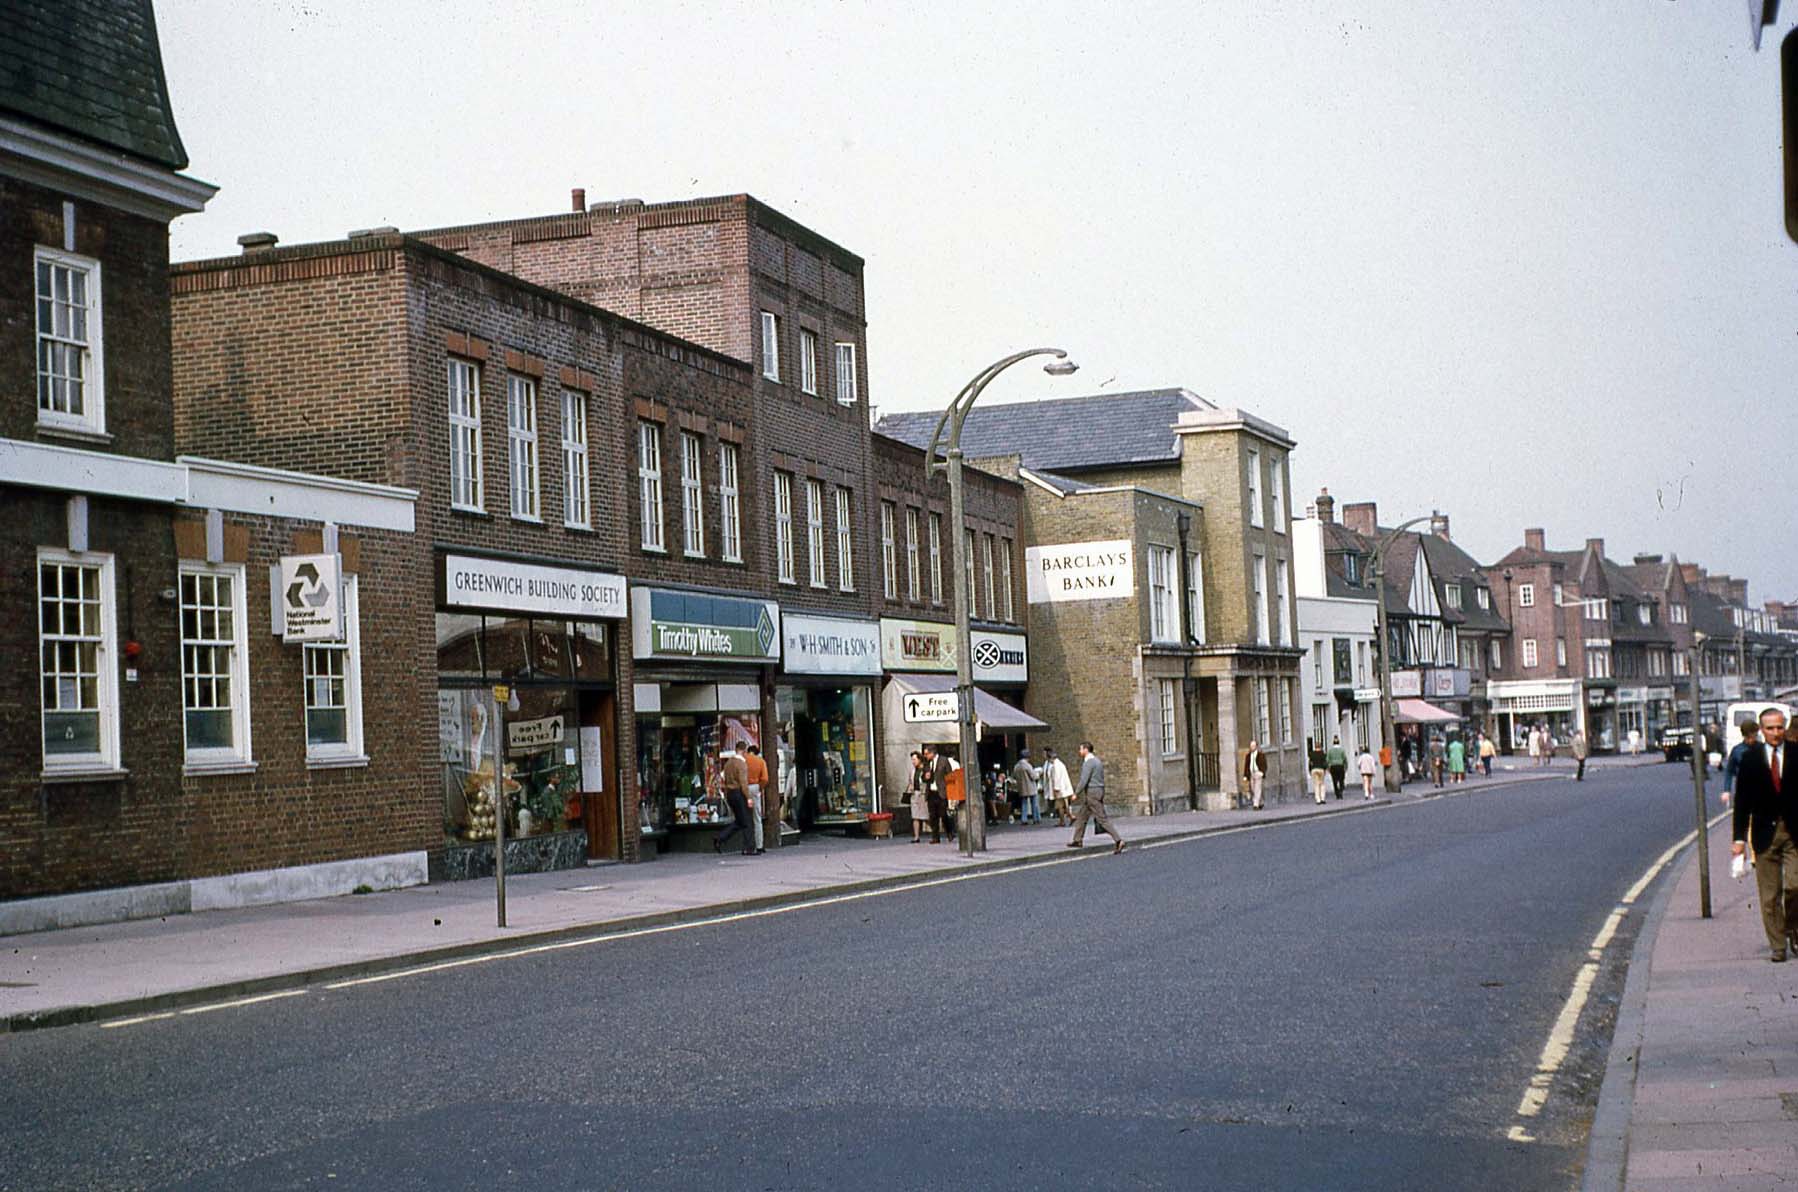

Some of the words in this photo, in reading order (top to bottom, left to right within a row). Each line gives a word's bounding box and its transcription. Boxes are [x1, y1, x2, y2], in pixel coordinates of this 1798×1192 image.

[1042, 553, 1127, 571] BARCLAYS
[455, 571, 523, 596] GREENWICH
[528, 579, 577, 601] BUILDING
[581, 585, 620, 604] SOCIETY
[1063, 576, 1107, 590] BANK
[657, 625, 698, 655] Timothy
[698, 628, 732, 653] Whites
[850, 638, 867, 656] SON
[929, 698, 948, 706] Free
[937, 707, 956, 717] park
